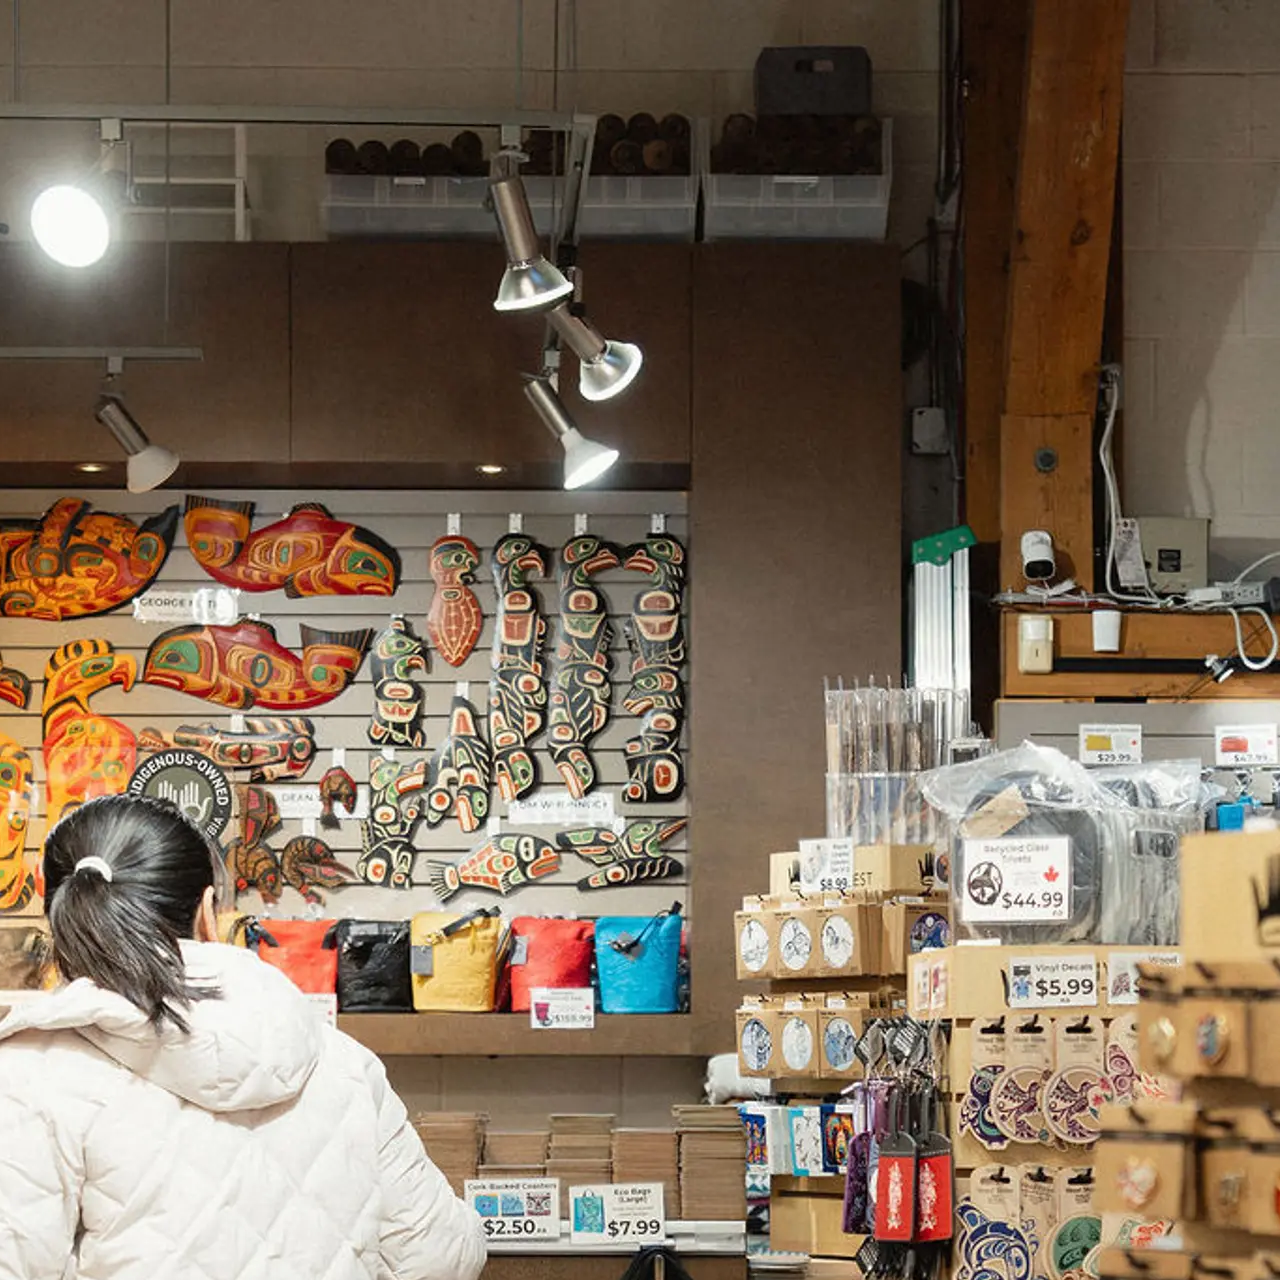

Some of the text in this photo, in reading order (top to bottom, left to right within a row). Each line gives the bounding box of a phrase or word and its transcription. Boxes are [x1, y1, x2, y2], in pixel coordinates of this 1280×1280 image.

[140, 598, 186, 607] GEORGE
[282, 792, 313, 802] DEAN
[820, 878, 848, 891] $8.99
[1001, 891, 1063, 909] $44.99
[1035, 963, 1093, 973] Vinyl Decals
[1036, 978, 1094, 997] $5.99
[631, 1188, 652, 1197] Bags
[484, 1219, 536, 1236] $2.50
[608, 1218, 661, 1237] $7.99
